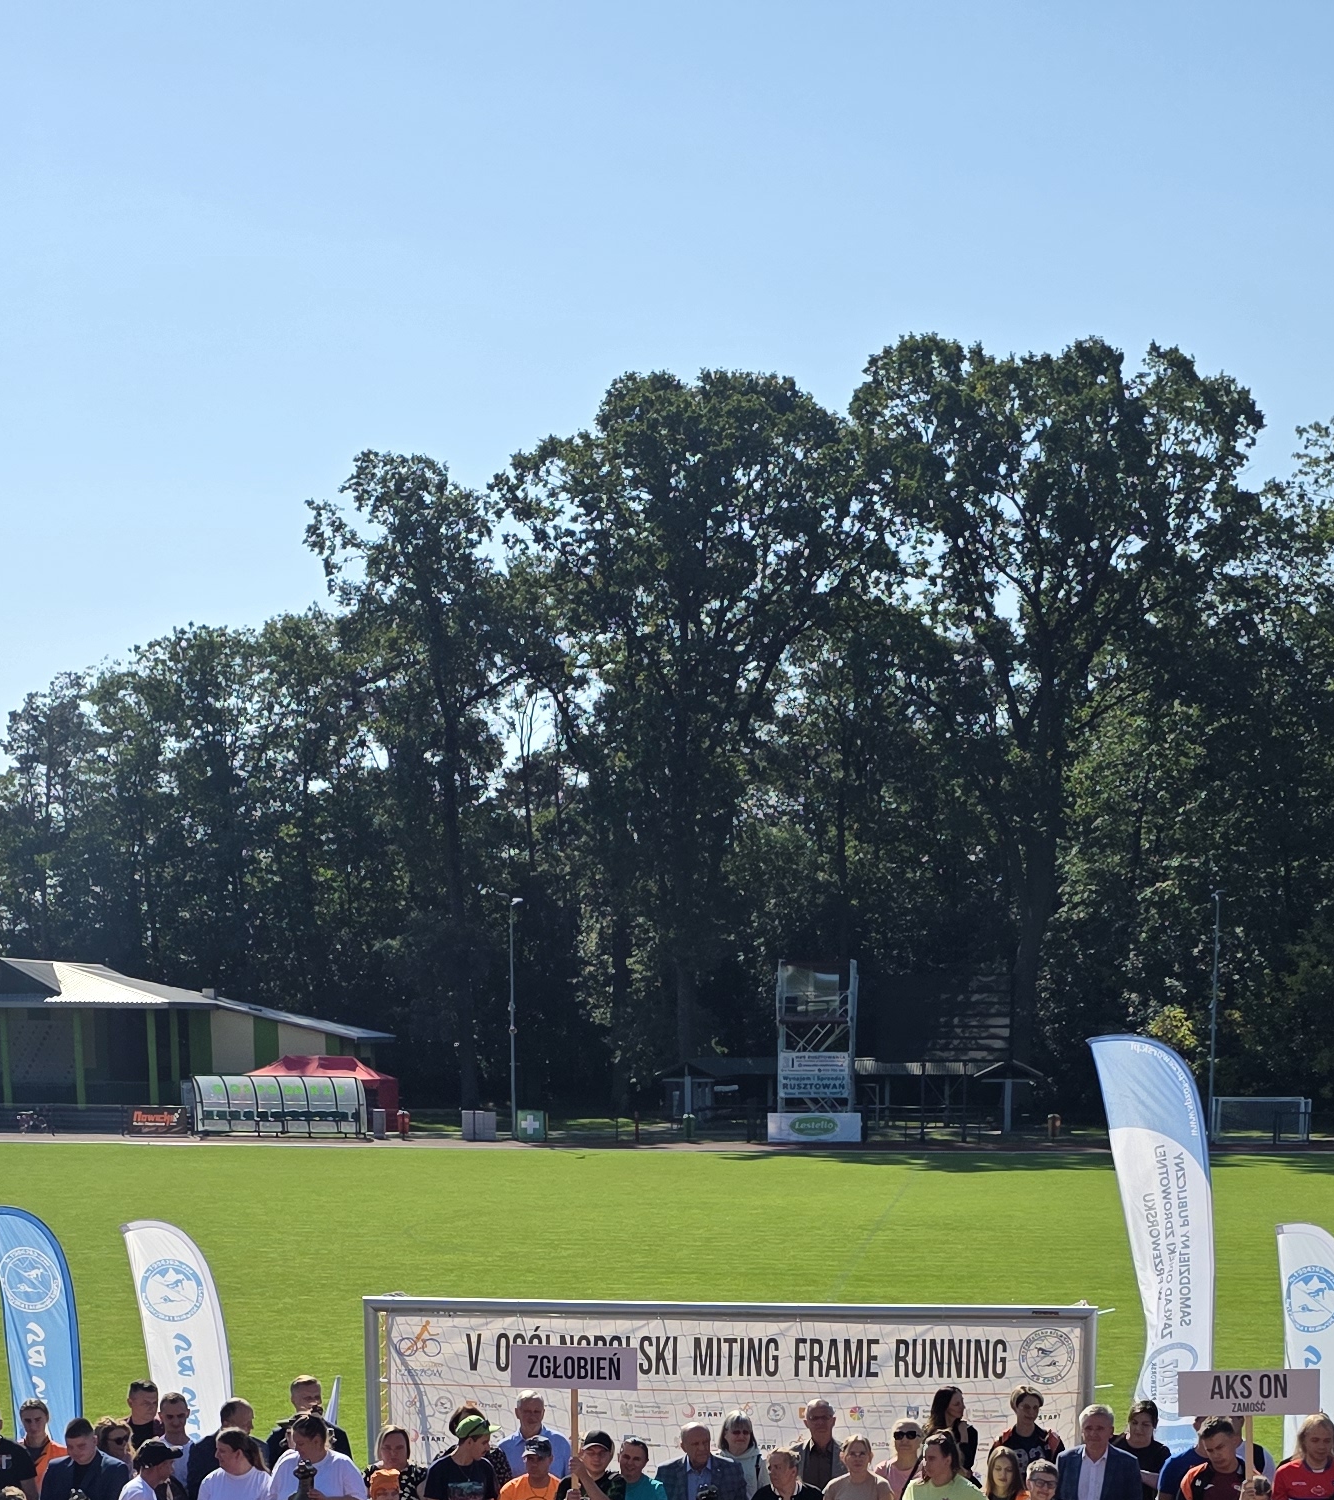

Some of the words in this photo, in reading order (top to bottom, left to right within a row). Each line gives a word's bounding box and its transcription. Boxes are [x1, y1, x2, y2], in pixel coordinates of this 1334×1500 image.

[466, 1333, 482, 1371] V
[693, 1337, 787, 1377] MITING
[794, 1337, 880, 1378] FRAME
[895, 1338, 1007, 1380] RUNNING
[528, 1352, 621, 1380] ZGŁOBIEŃ
[1210, 1373, 1252, 1399] AKS
[1259, 1373, 1288, 1398] ON
[1231, 1399, 1266, 1412] ZAMOŚĆ
